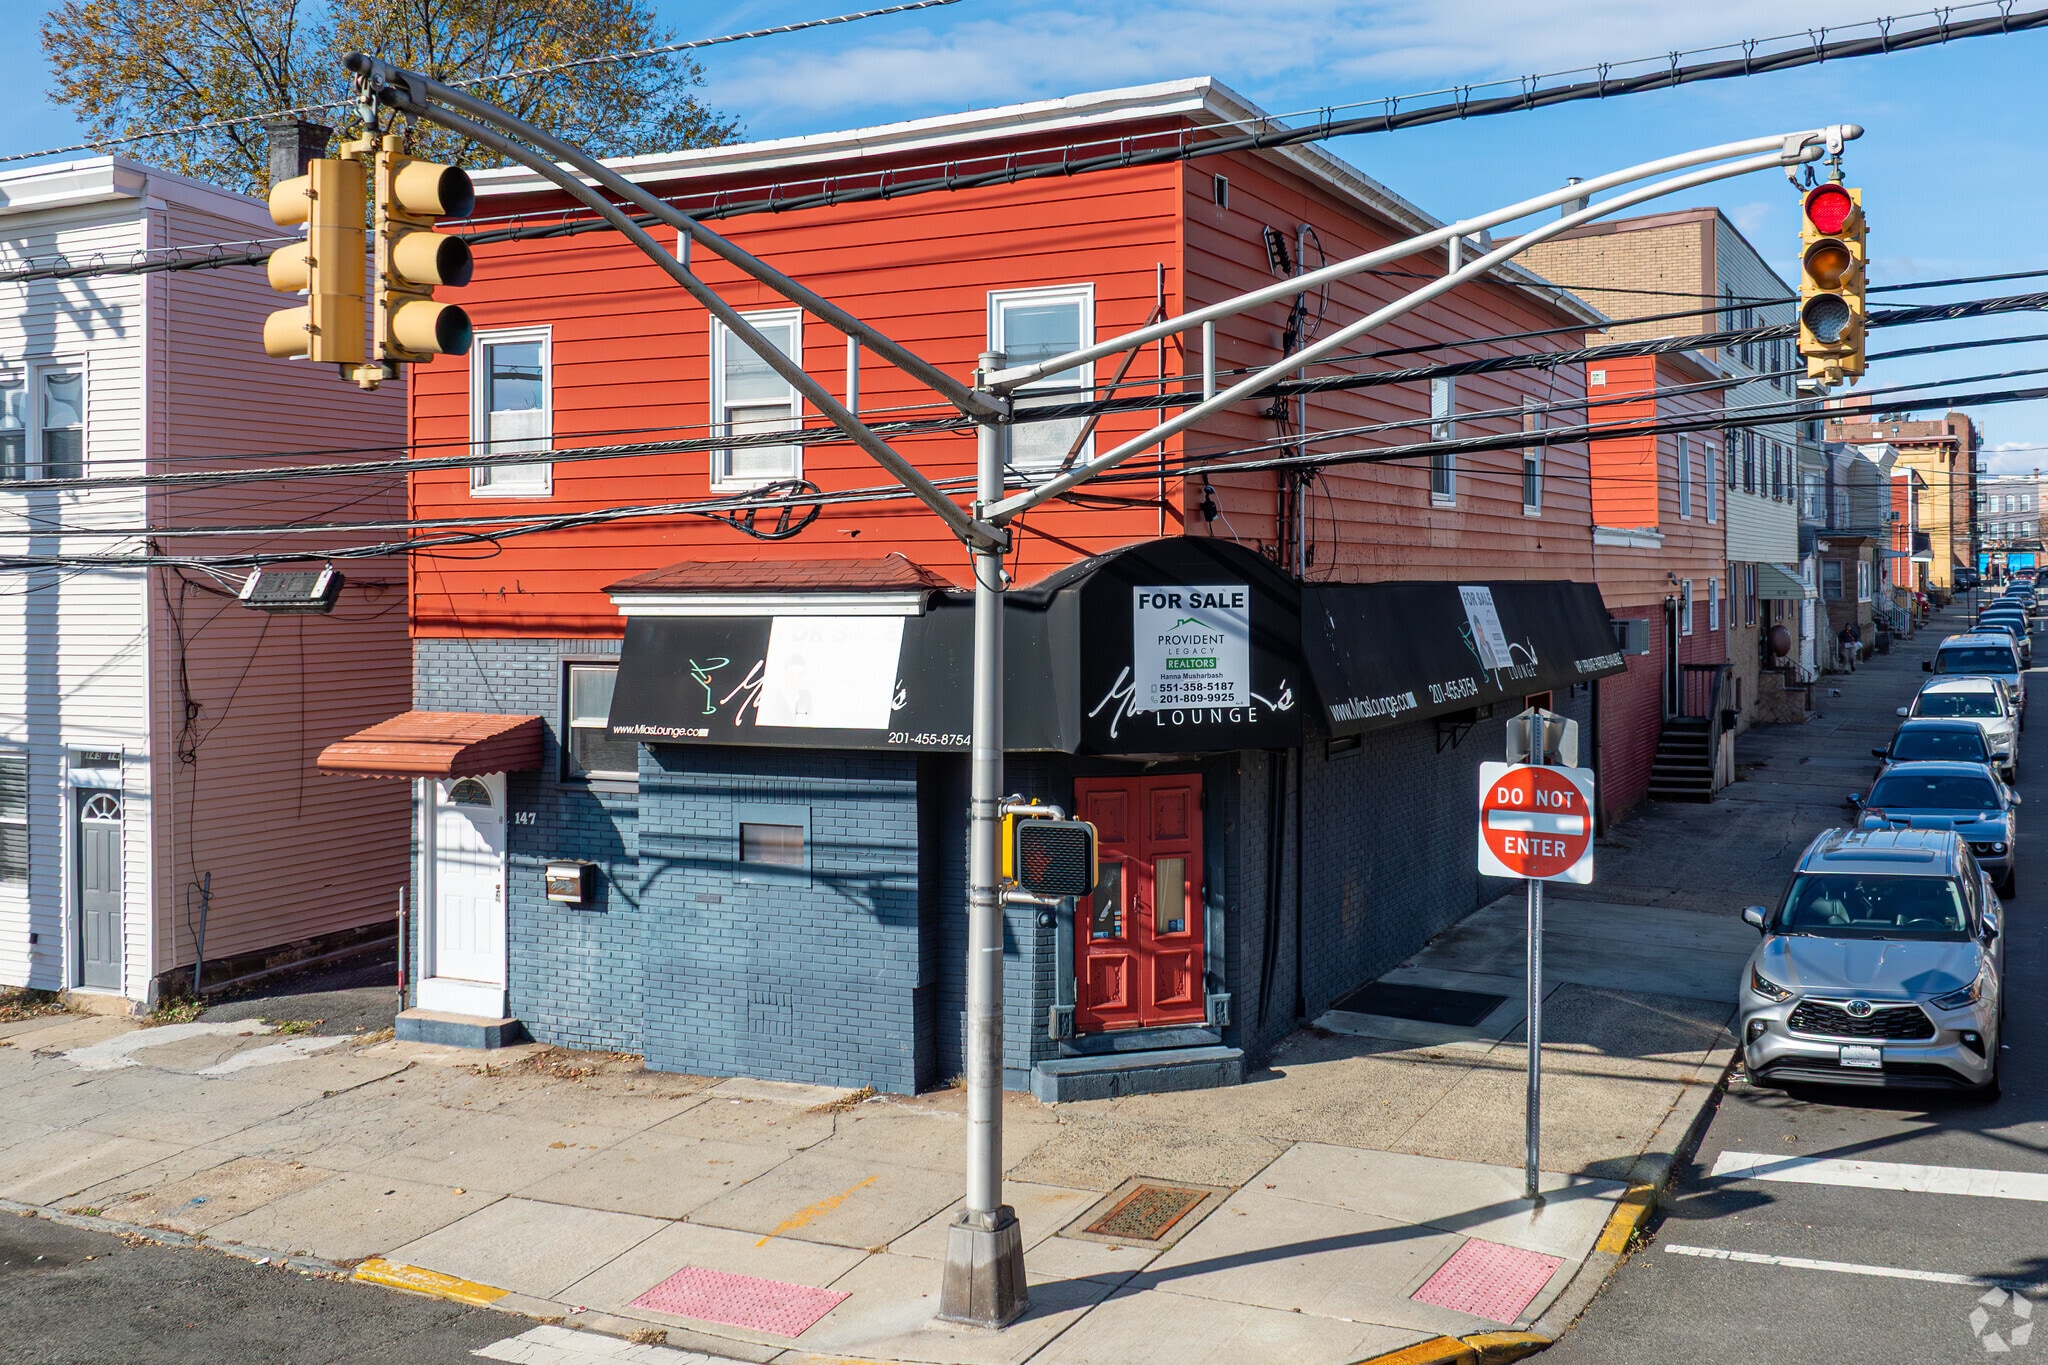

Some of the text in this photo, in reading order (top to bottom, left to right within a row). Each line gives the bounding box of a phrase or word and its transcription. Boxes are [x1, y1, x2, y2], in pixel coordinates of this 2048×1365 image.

[1139, 592, 1244, 609] FOR SALE
[1462, 591, 1493, 607] FOR SALE
[1158, 634, 1225, 646] PROVIDENT
[1168, 647, 1216, 655] LEGACY
[1168, 659, 1215, 669] REALTORS
[1508, 662, 1537, 680] LOUNGE
[1182, 672, 1224, 680] Musharbash
[1159, 682, 1235, 693] 551-358-5187
[1428, 677, 1479, 704] 201-455-8754
[1159, 693, 1235, 704] 201-809-9925
[1329, 691, 1413, 722] www.MiasLounge.co
[1156, 707, 1258, 727] LOUNGE
[613, 724, 704, 739] www.MiasLounge.co
[888, 731, 972, 747] 201-455-8754
[1497, 787, 1574, 808] DO NOT
[514, 811, 537, 825] 147
[1504, 836, 1566, 858] ENTER
